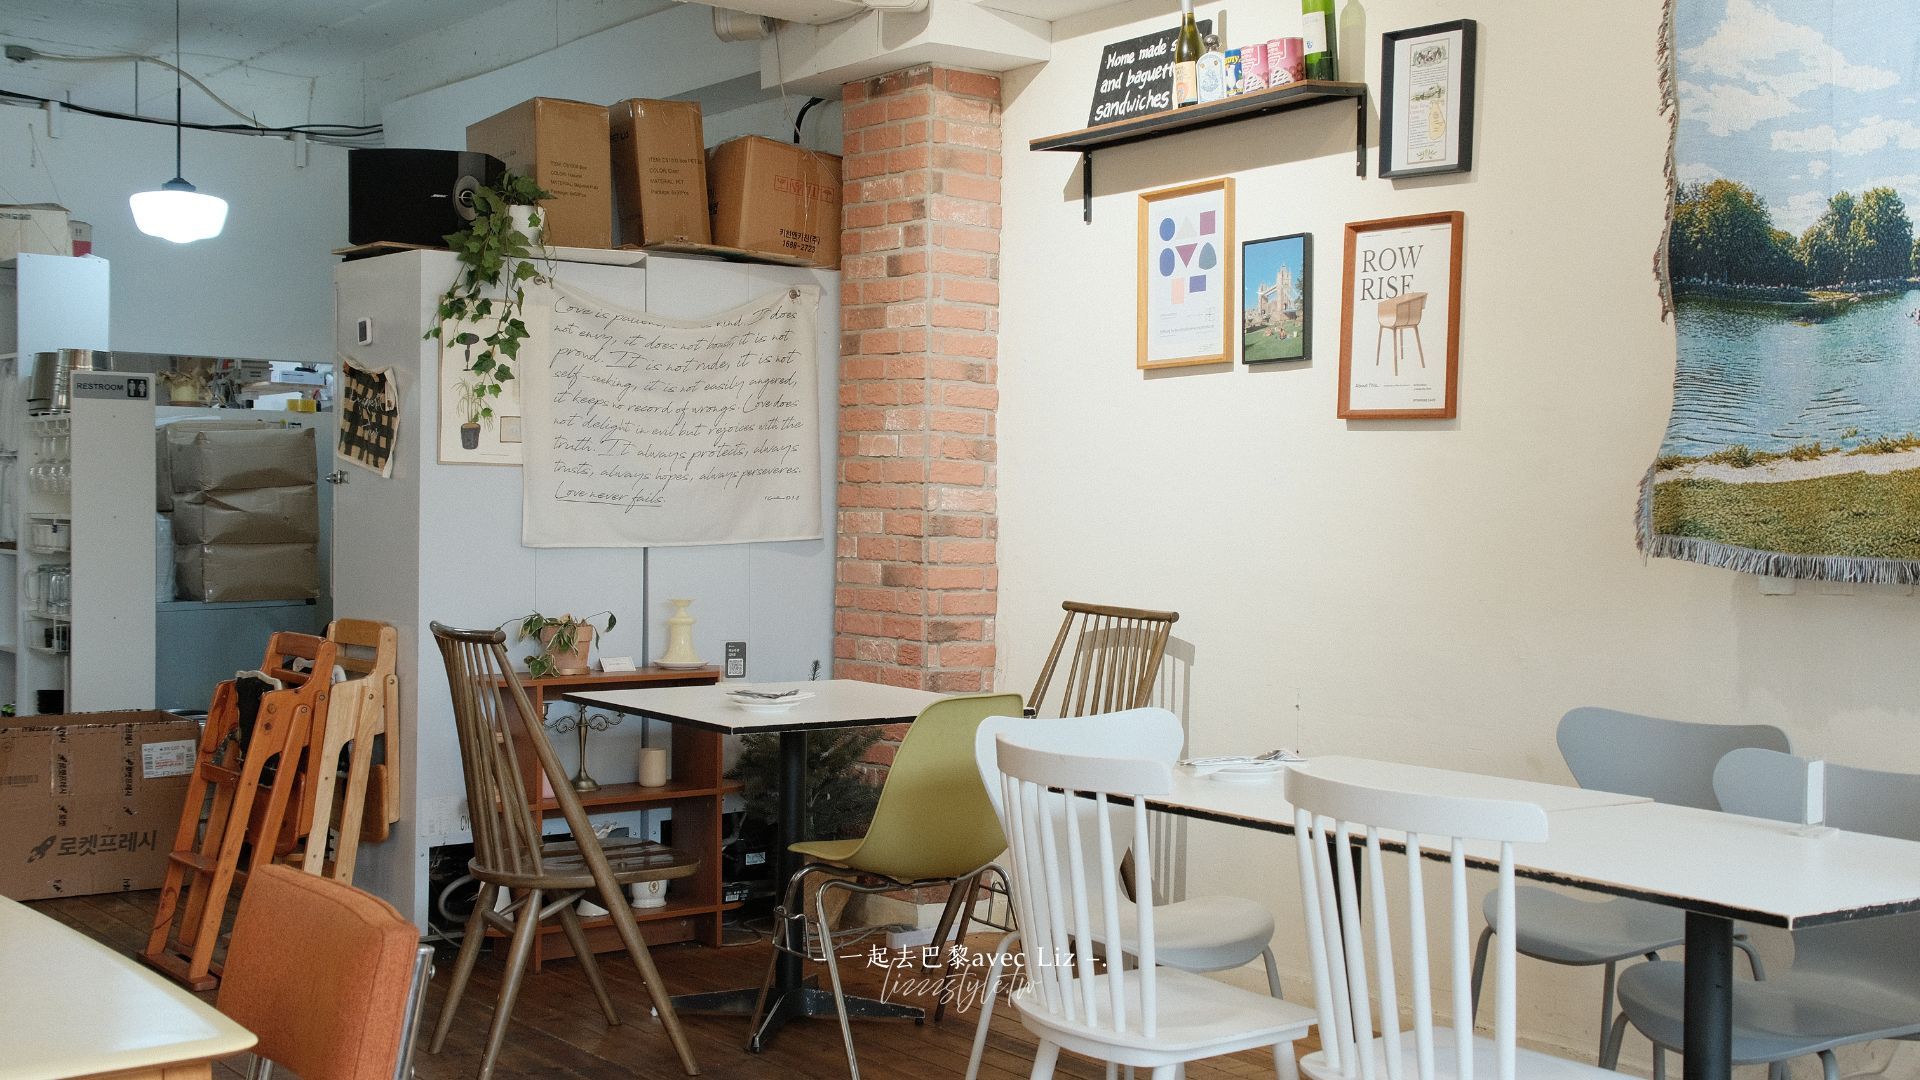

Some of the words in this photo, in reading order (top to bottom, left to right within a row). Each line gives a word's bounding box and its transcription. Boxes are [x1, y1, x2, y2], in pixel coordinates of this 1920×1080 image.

[1106, 51, 1135, 69] Home
[1139, 38, 1167, 60] made
[1100, 72, 1123, 94] and
[1126, 61, 1176, 90] baguett
[1094, 89, 1170, 121] sandwiches
[1362, 244, 1424, 273] ROW
[555, 296, 593, 314] Love
[595, 308, 611, 319] is
[769, 305, 798, 320] does
[554, 322, 580, 334] not
[624, 334, 647, 346] it
[644, 335, 678, 350] does
[680, 337, 708, 351] not
[738, 331, 756, 345] it
[755, 333, 768, 343] is
[771, 328, 794, 342] not
[606, 350, 648, 368] It
[645, 359, 663, 371] is
[666, 357, 700, 373] not
[695, 352, 730, 371] rude,
[737, 350, 758, 367] it
[758, 353, 773, 364] is
[775, 348, 802, 364] not
[76, 382, 124, 391] RESTROOM
[552, 364, 637, 402] self-seeking,
[643, 379, 666, 391] it
[663, 382, 678, 392] is
[680, 378, 705, 392] not
[704, 376, 745, 399] easily
[748, 371, 797, 400] angered,
[553, 390, 574, 403] it
[573, 389, 610, 416] keeps
[627, 401, 673, 414] record
[742, 393, 773, 414] Love
[773, 394, 799, 408] does
[553, 413, 582, 426] not
[635, 424, 649, 434] in
[651, 424, 677, 437] evil
[678, 421, 708, 437] but
[708, 422, 756, 447] rejoices
[758, 416, 779, 431] with
[780, 416, 804, 431] the
[597, 438, 638, 457] It
[637, 443, 688, 472] always
[753, 438, 800, 465] always
[555, 480, 588, 499] Love
[588, 490, 629, 501] never
[600, 464, 650, 491] always
[698, 466, 739, 490] always
[57, 831, 157, 856] 로켓프레시
